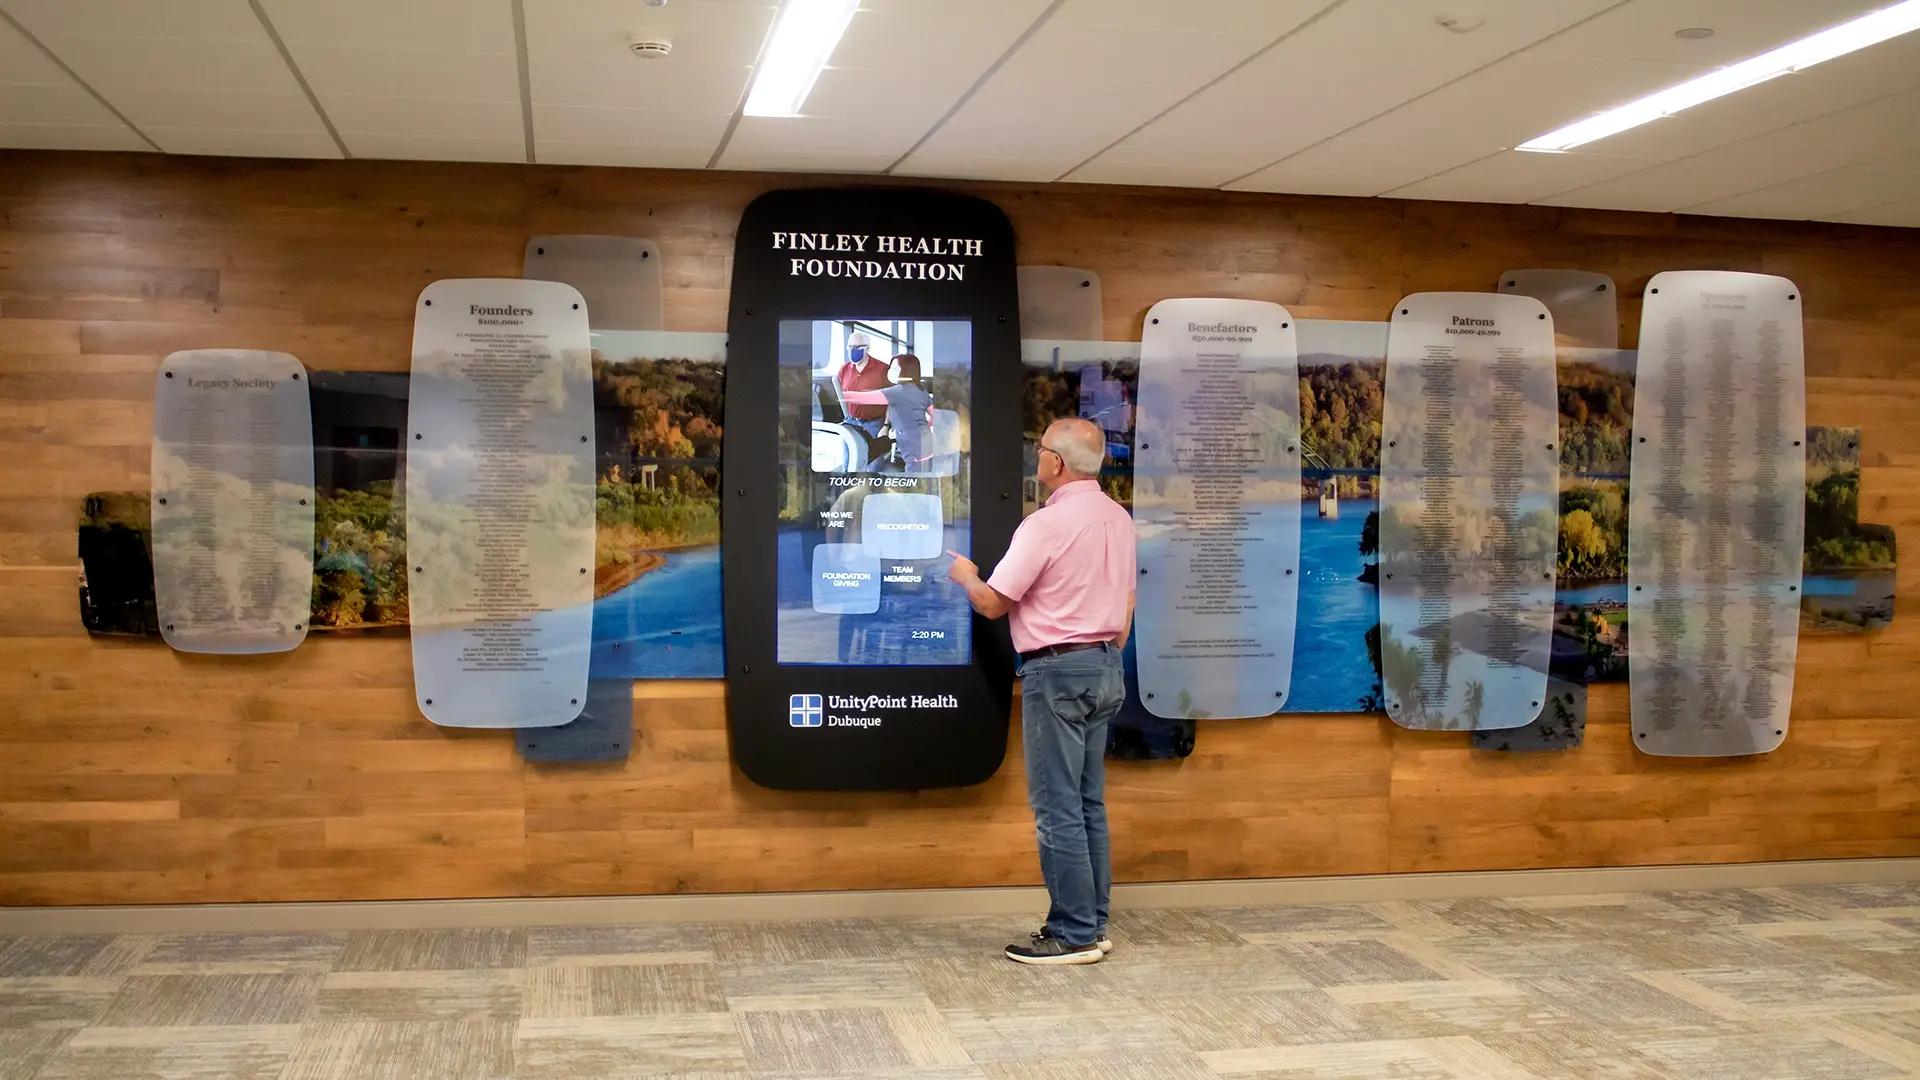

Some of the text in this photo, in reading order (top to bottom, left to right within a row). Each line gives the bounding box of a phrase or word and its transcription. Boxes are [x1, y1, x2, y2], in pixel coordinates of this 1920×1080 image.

[772, 232, 984, 257] FINLEY HEALTH
[790, 258, 965, 281] FOUNDATION
[470, 304, 533, 316] Founders
[1452, 315, 1495, 327] Patrons
[1187, 322, 1258, 334] Benefactors
[188, 377, 277, 391] Legacy Society
[829, 477, 917, 488] TOUCH TO BEGIN
[820, 511, 853, 519] WHO WE
[828, 520, 845, 528] ARE
[876, 523, 930, 531] RECOGNITION
[822, 572, 871, 581] FOUNDATION
[883, 575, 922, 583] MEMBERS
[832, 580, 860, 588] GIVING
[911, 631, 944, 639] 2:20 PM
[828, 694, 958, 711] UnityPoint Health
[828, 715, 881, 729] Dubuque
